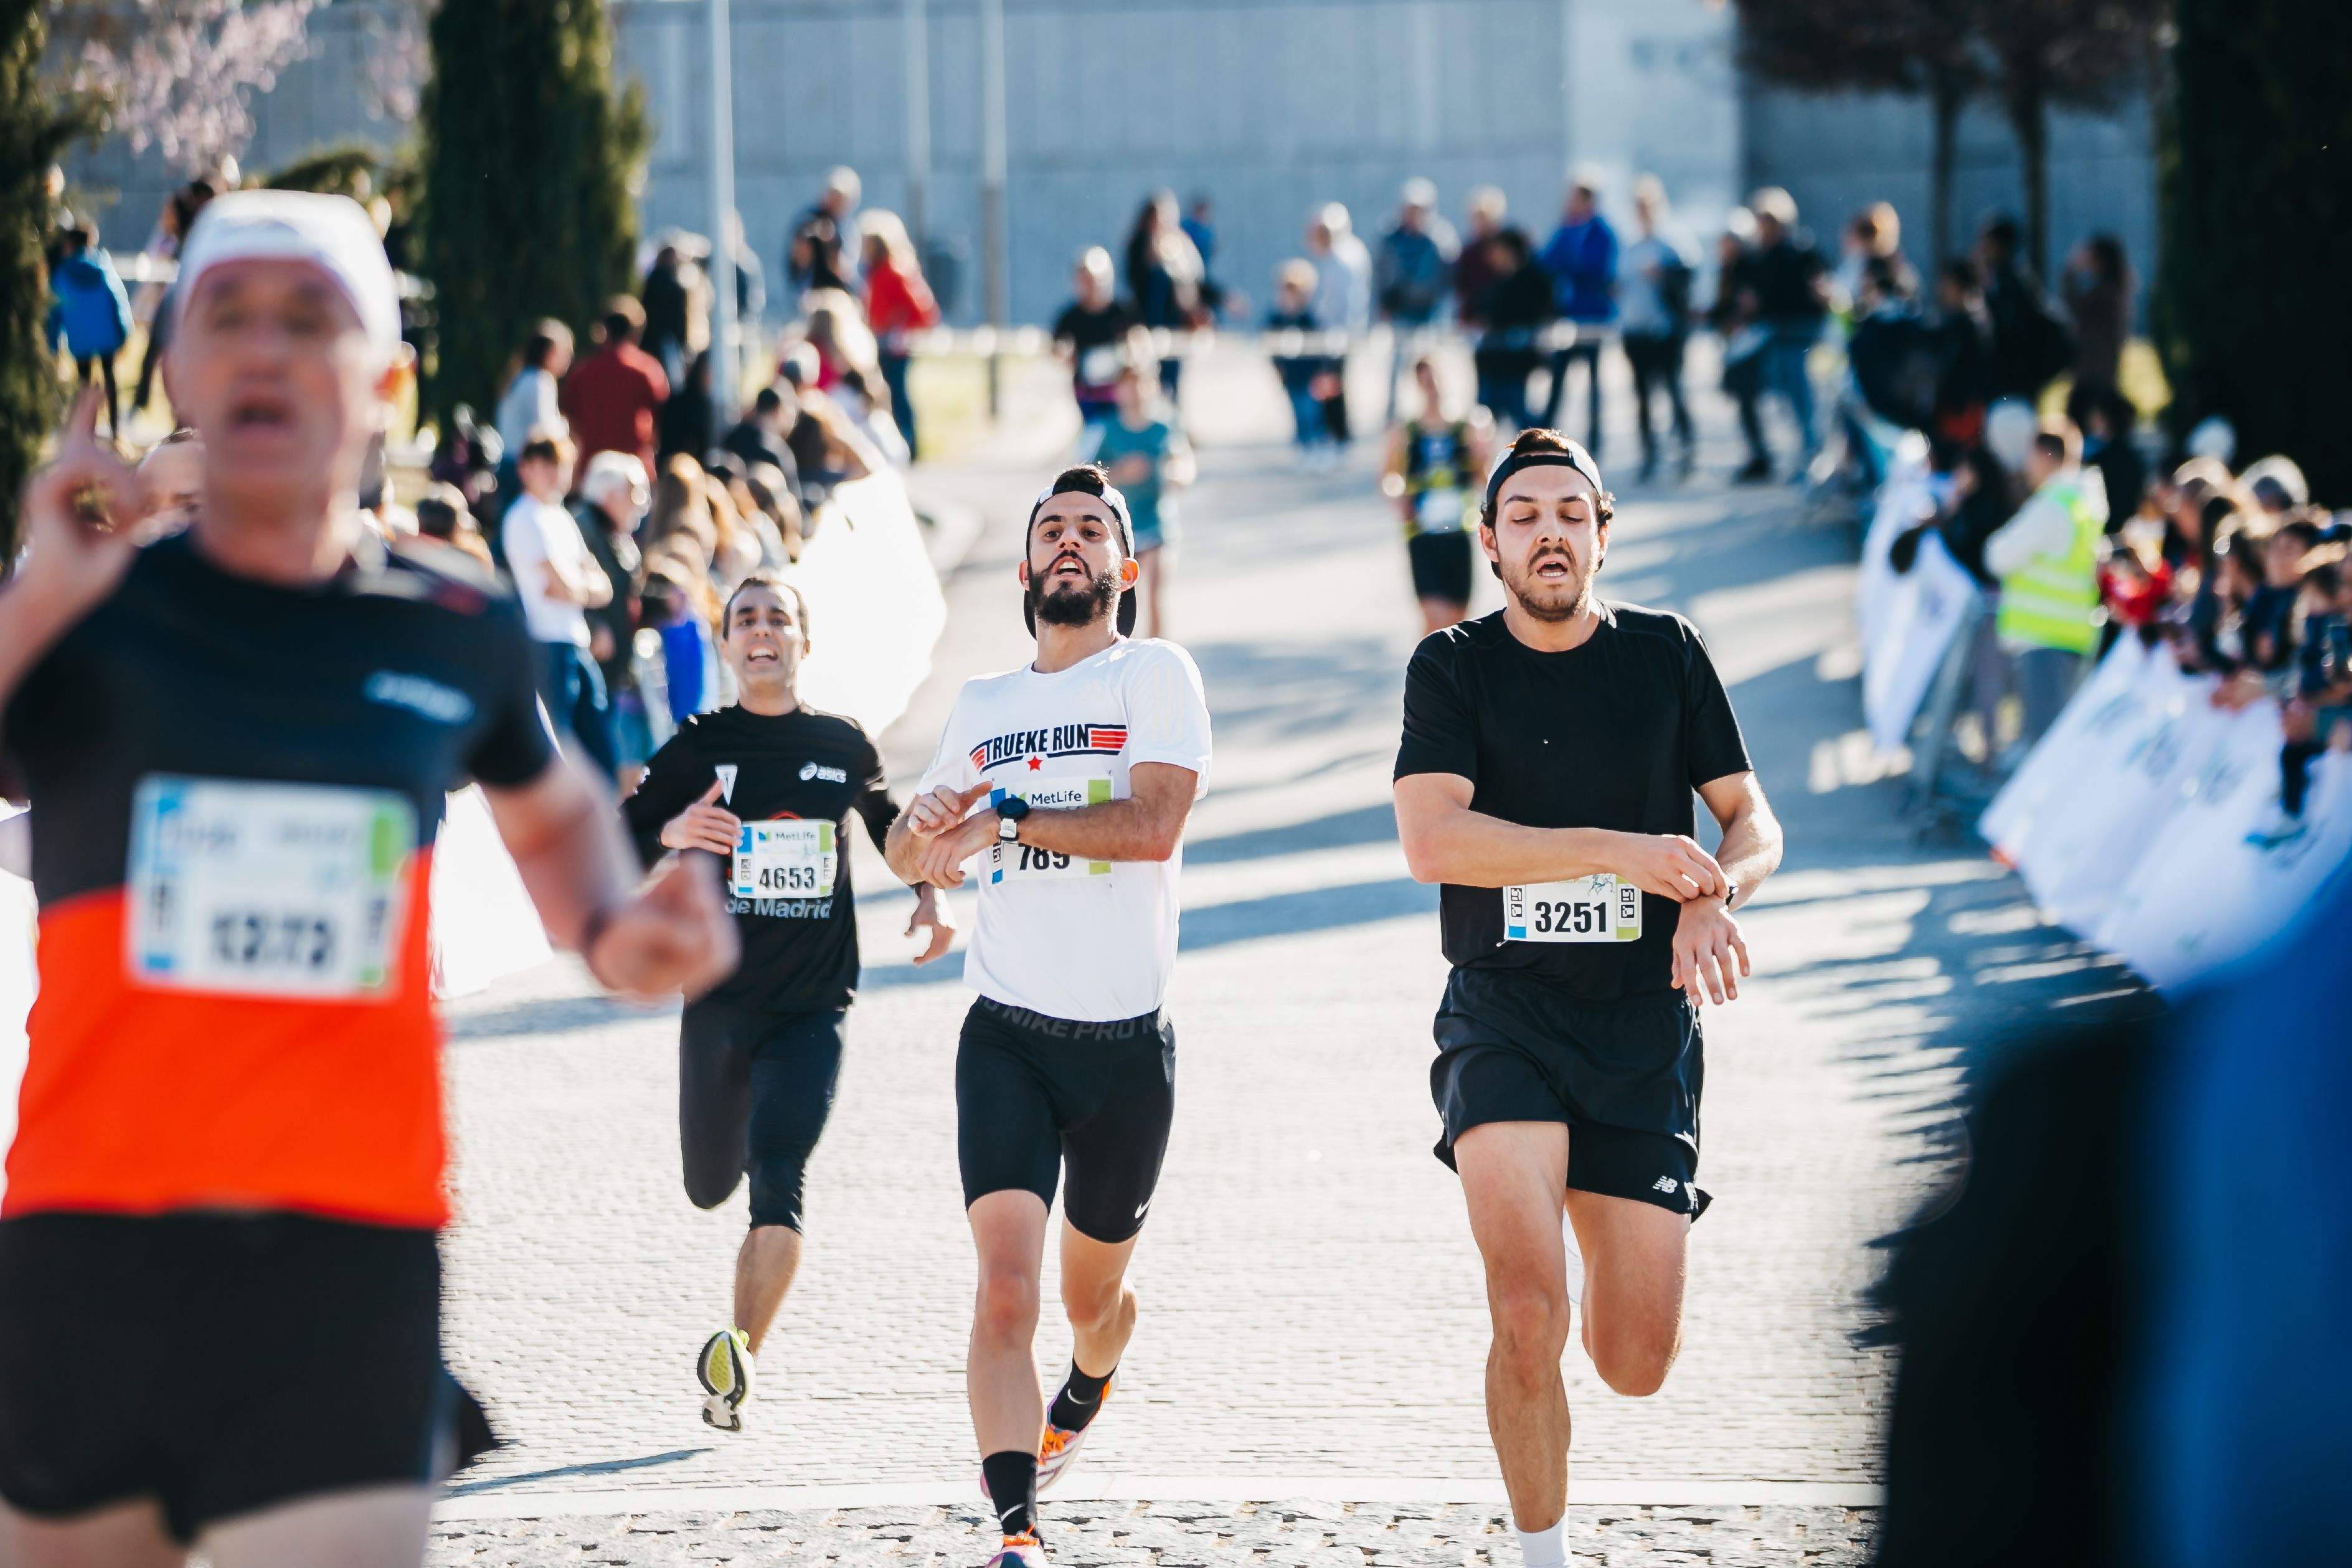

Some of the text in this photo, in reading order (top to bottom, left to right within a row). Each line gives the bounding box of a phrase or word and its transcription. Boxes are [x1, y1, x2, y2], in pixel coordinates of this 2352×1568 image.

[986, 724, 1090, 763] TRUEKE RUN
[1031, 790, 1082, 805] MetLife
[776, 831, 816, 841] MetLife
[758, 866, 815, 890] 4653
[724, 898, 833, 920] de Madrid
[1534, 901, 1607, 934] 3251
[1003, 1006, 1070, 1038] NIKE
[1073, 1018, 1135, 1042] PRO
